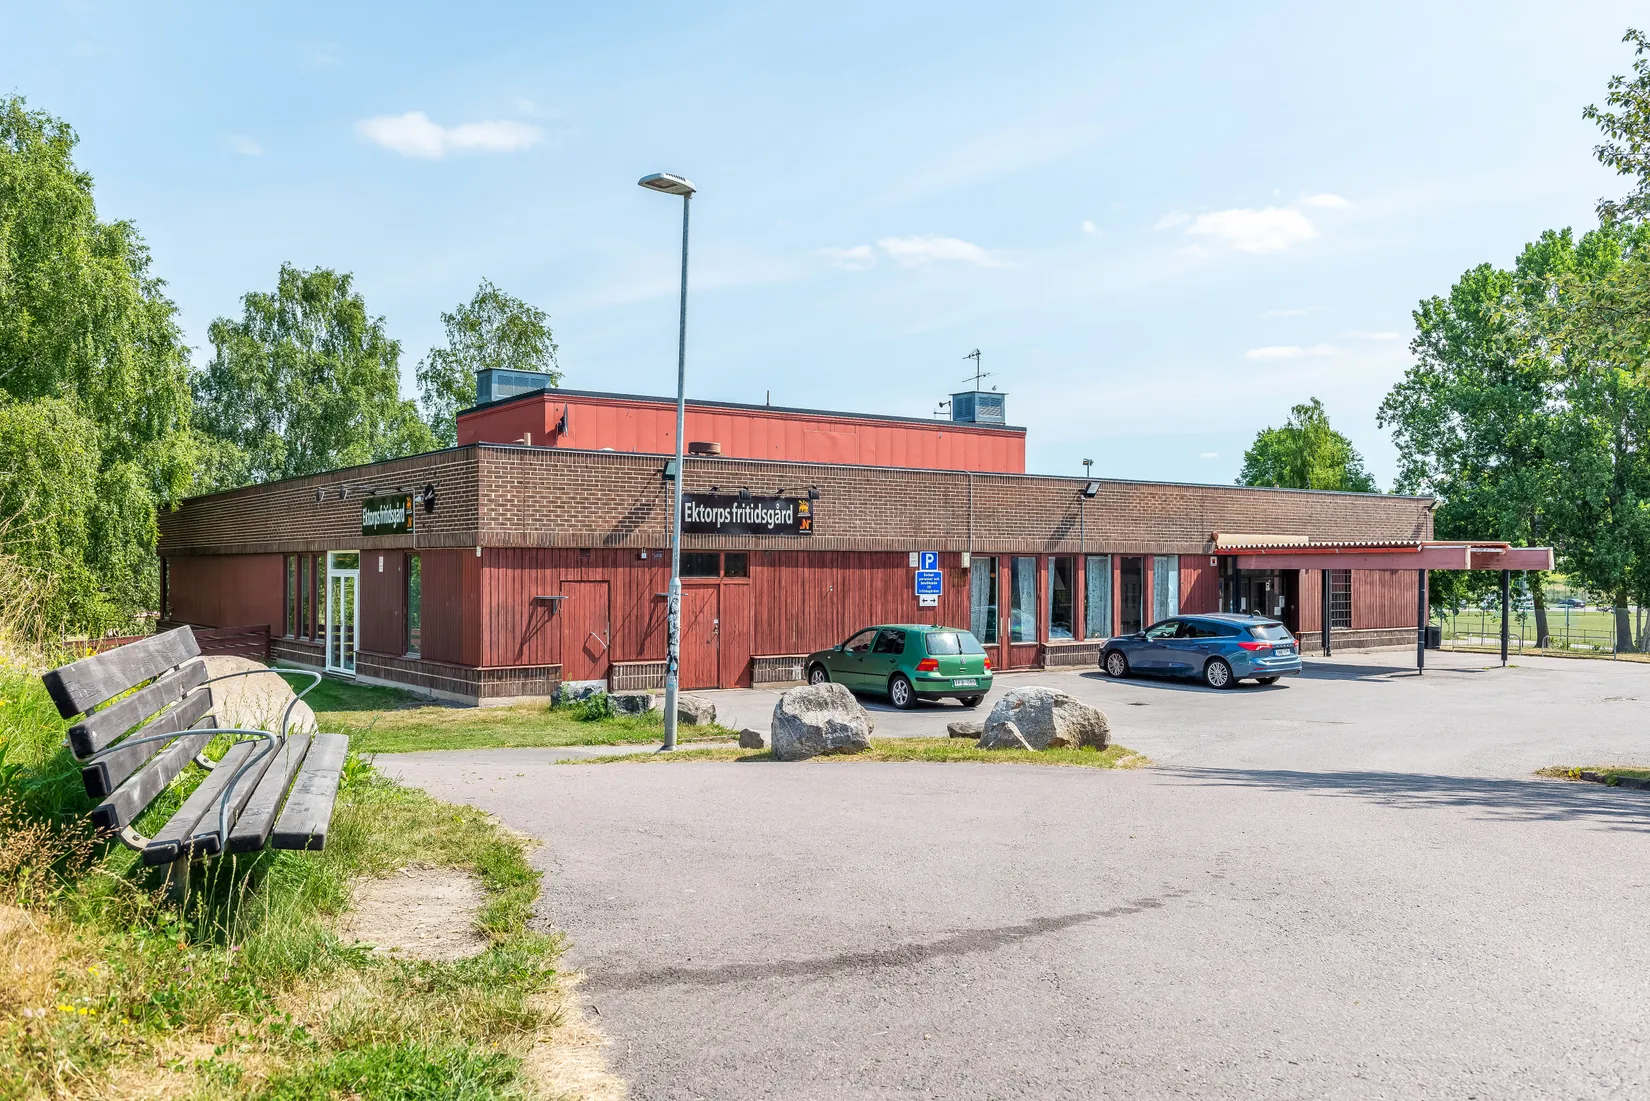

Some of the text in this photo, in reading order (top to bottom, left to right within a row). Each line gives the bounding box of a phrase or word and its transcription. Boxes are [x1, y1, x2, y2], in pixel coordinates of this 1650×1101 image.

[684, 501, 793, 529] Ektorps fritidsgård
[926, 554, 935, 569] P
